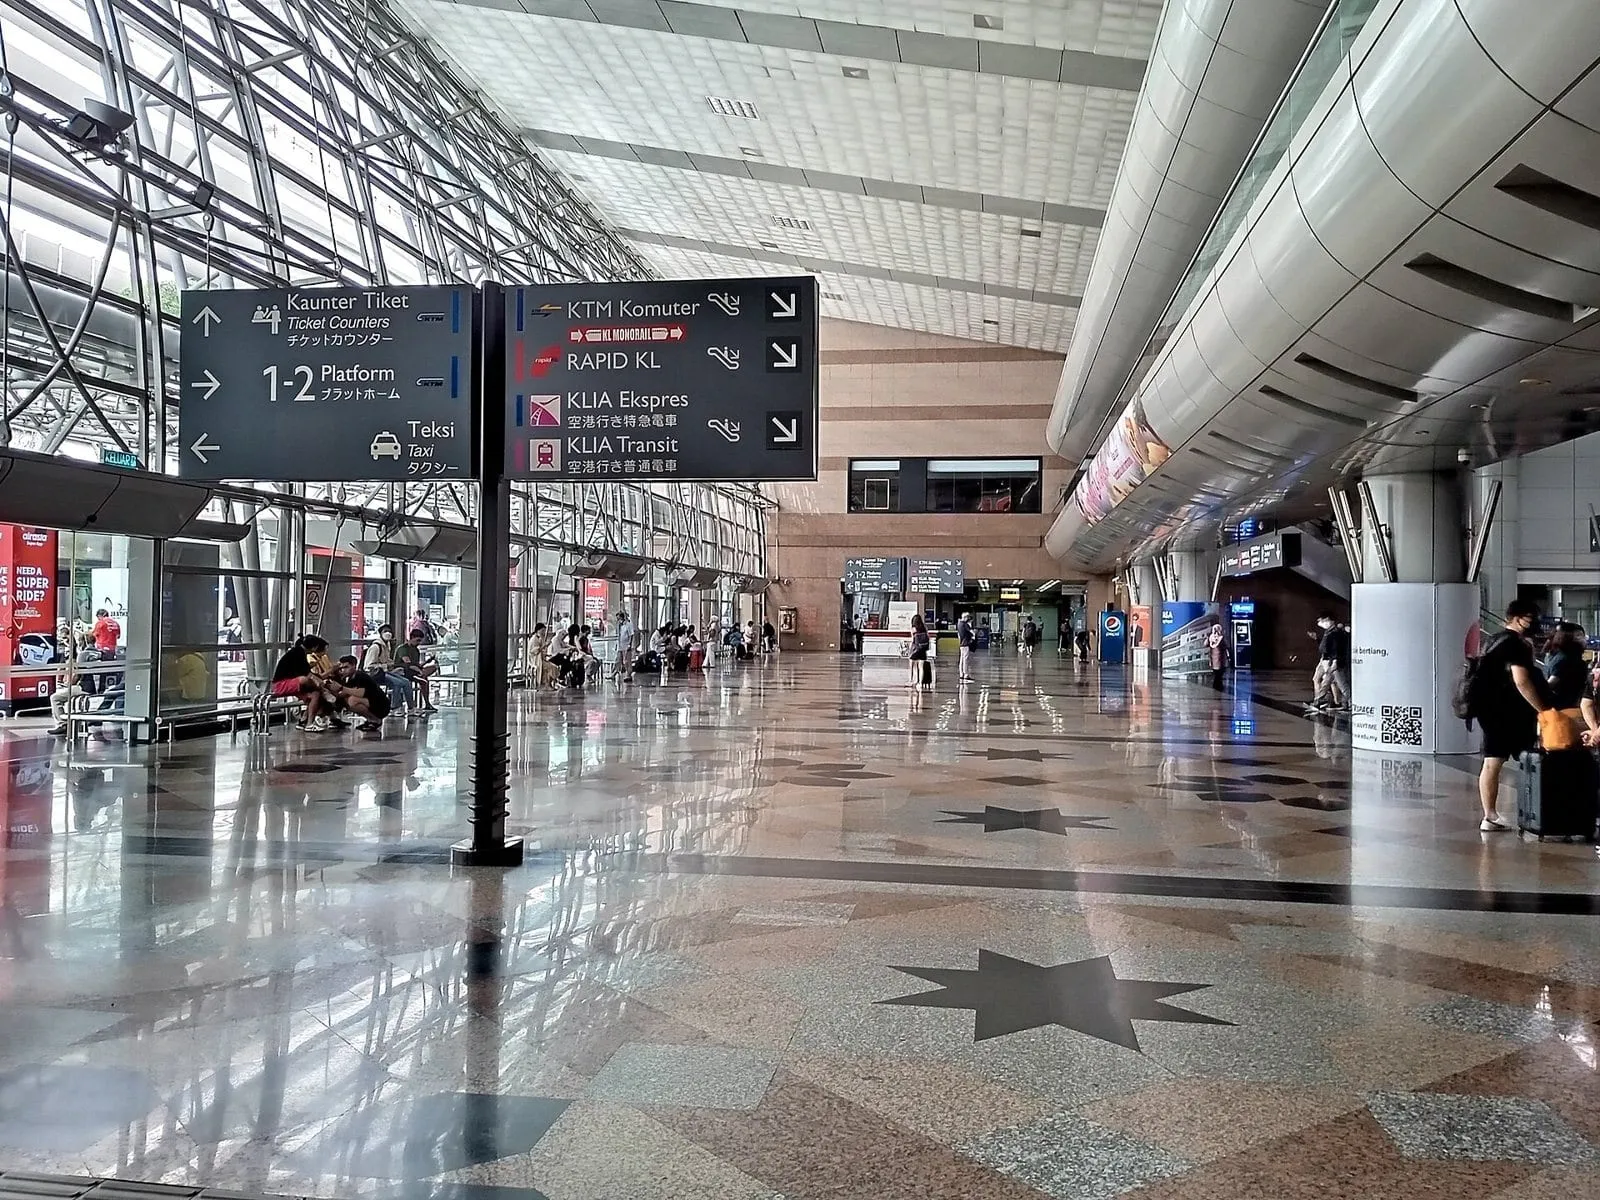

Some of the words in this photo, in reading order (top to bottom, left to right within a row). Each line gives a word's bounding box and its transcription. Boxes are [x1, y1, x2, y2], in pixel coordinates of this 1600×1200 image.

[287, 293, 357, 311] Kaunter
[363, 292, 409, 310] Tiket
[568, 301, 612, 319] KTM
[619, 299, 700, 318] Komuter
[287, 316, 326, 330] Ticket
[329, 315, 390, 330] Counters
[287, 333, 393, 347] チケットカウンター
[602, 329, 612, 342] KL
[612, 327, 652, 341] MONORAIL
[567, 352, 629, 371] RAPID
[636, 351, 661, 369] KL
[321, 365, 394, 382] Platform
[263, 365, 315, 402] 1-2
[567, 391, 613, 409] KLIA
[619, 390, 689, 412] Ekspres
[567, 413, 678, 429] 空港行き特急電車
[407, 421, 455, 438] Teksi
[407, 444, 434, 457] Taxi
[567, 436, 613, 454] KLIA
[616, 435, 679, 453] Transit
[407, 462, 458, 475] タクシー
[567, 459, 677, 474] 空港行き普通電車
[16, 566, 36, 575] NEED
[36, 567, 43, 576] A
[16, 576, 49, 589] SUPER
[16, 589, 46, 602] RIDE?
